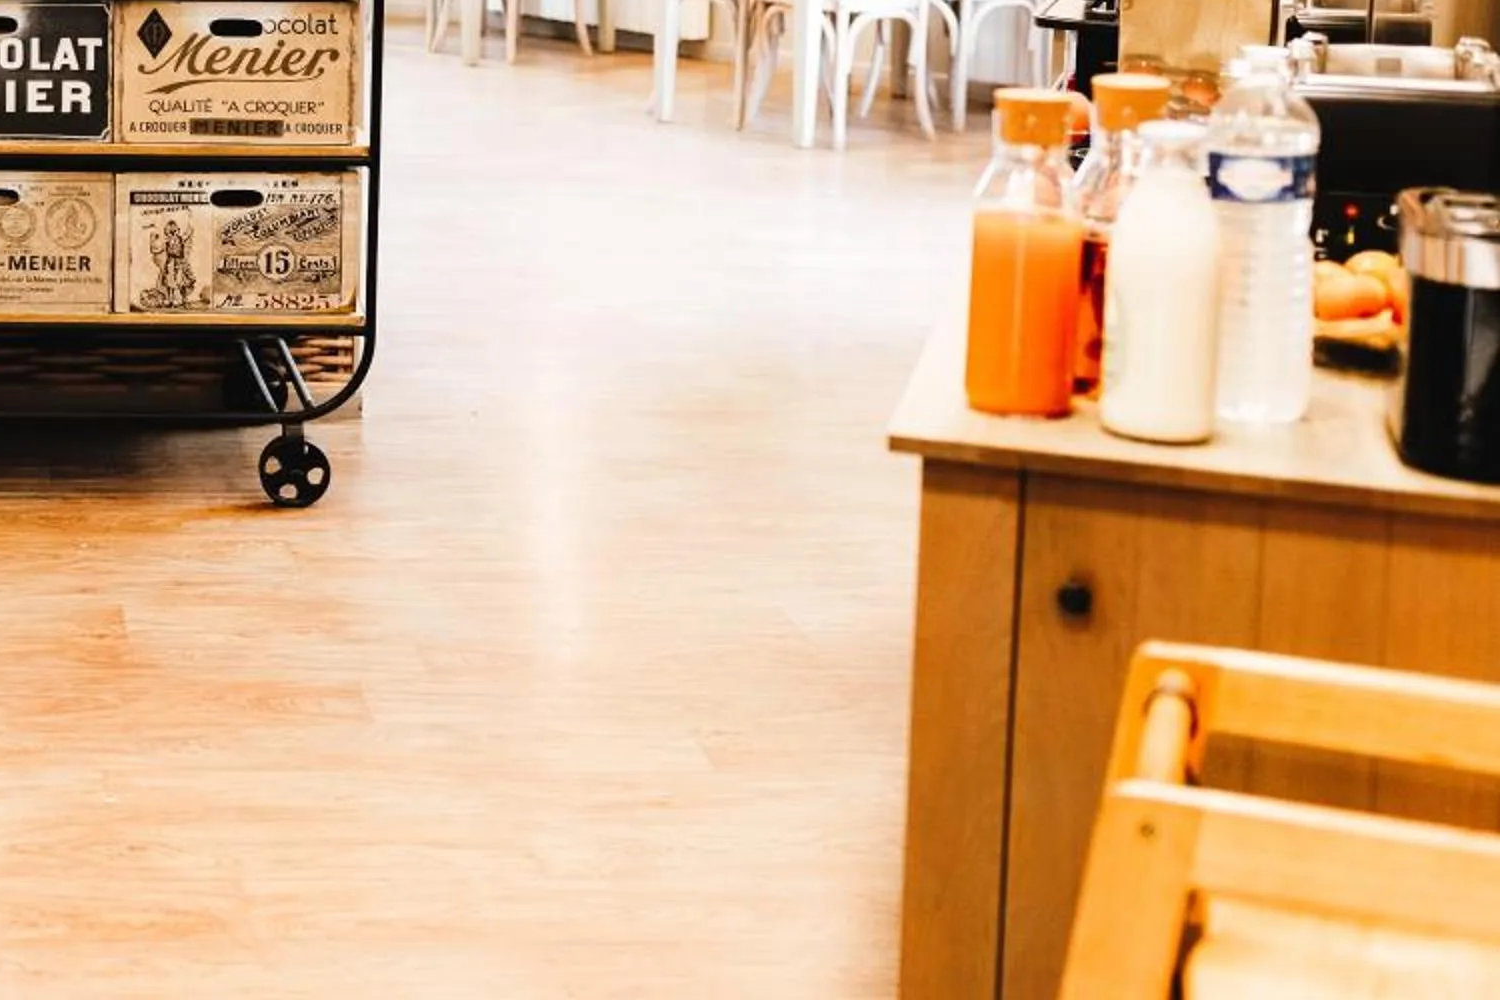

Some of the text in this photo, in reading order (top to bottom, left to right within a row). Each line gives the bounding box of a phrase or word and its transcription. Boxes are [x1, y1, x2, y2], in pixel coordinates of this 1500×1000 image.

[261, 13, 339, 35] ocolat
[137, 32, 340, 79] Menier
[148, 98, 213, 115] QUALITÉ
[129, 121, 137, 133] A
[139, 121, 187, 133] CROQUER
[191, 120, 278, 136] MENIER
[294, 122, 343, 134] CROQUER
[263, 250, 290, 275] 15
